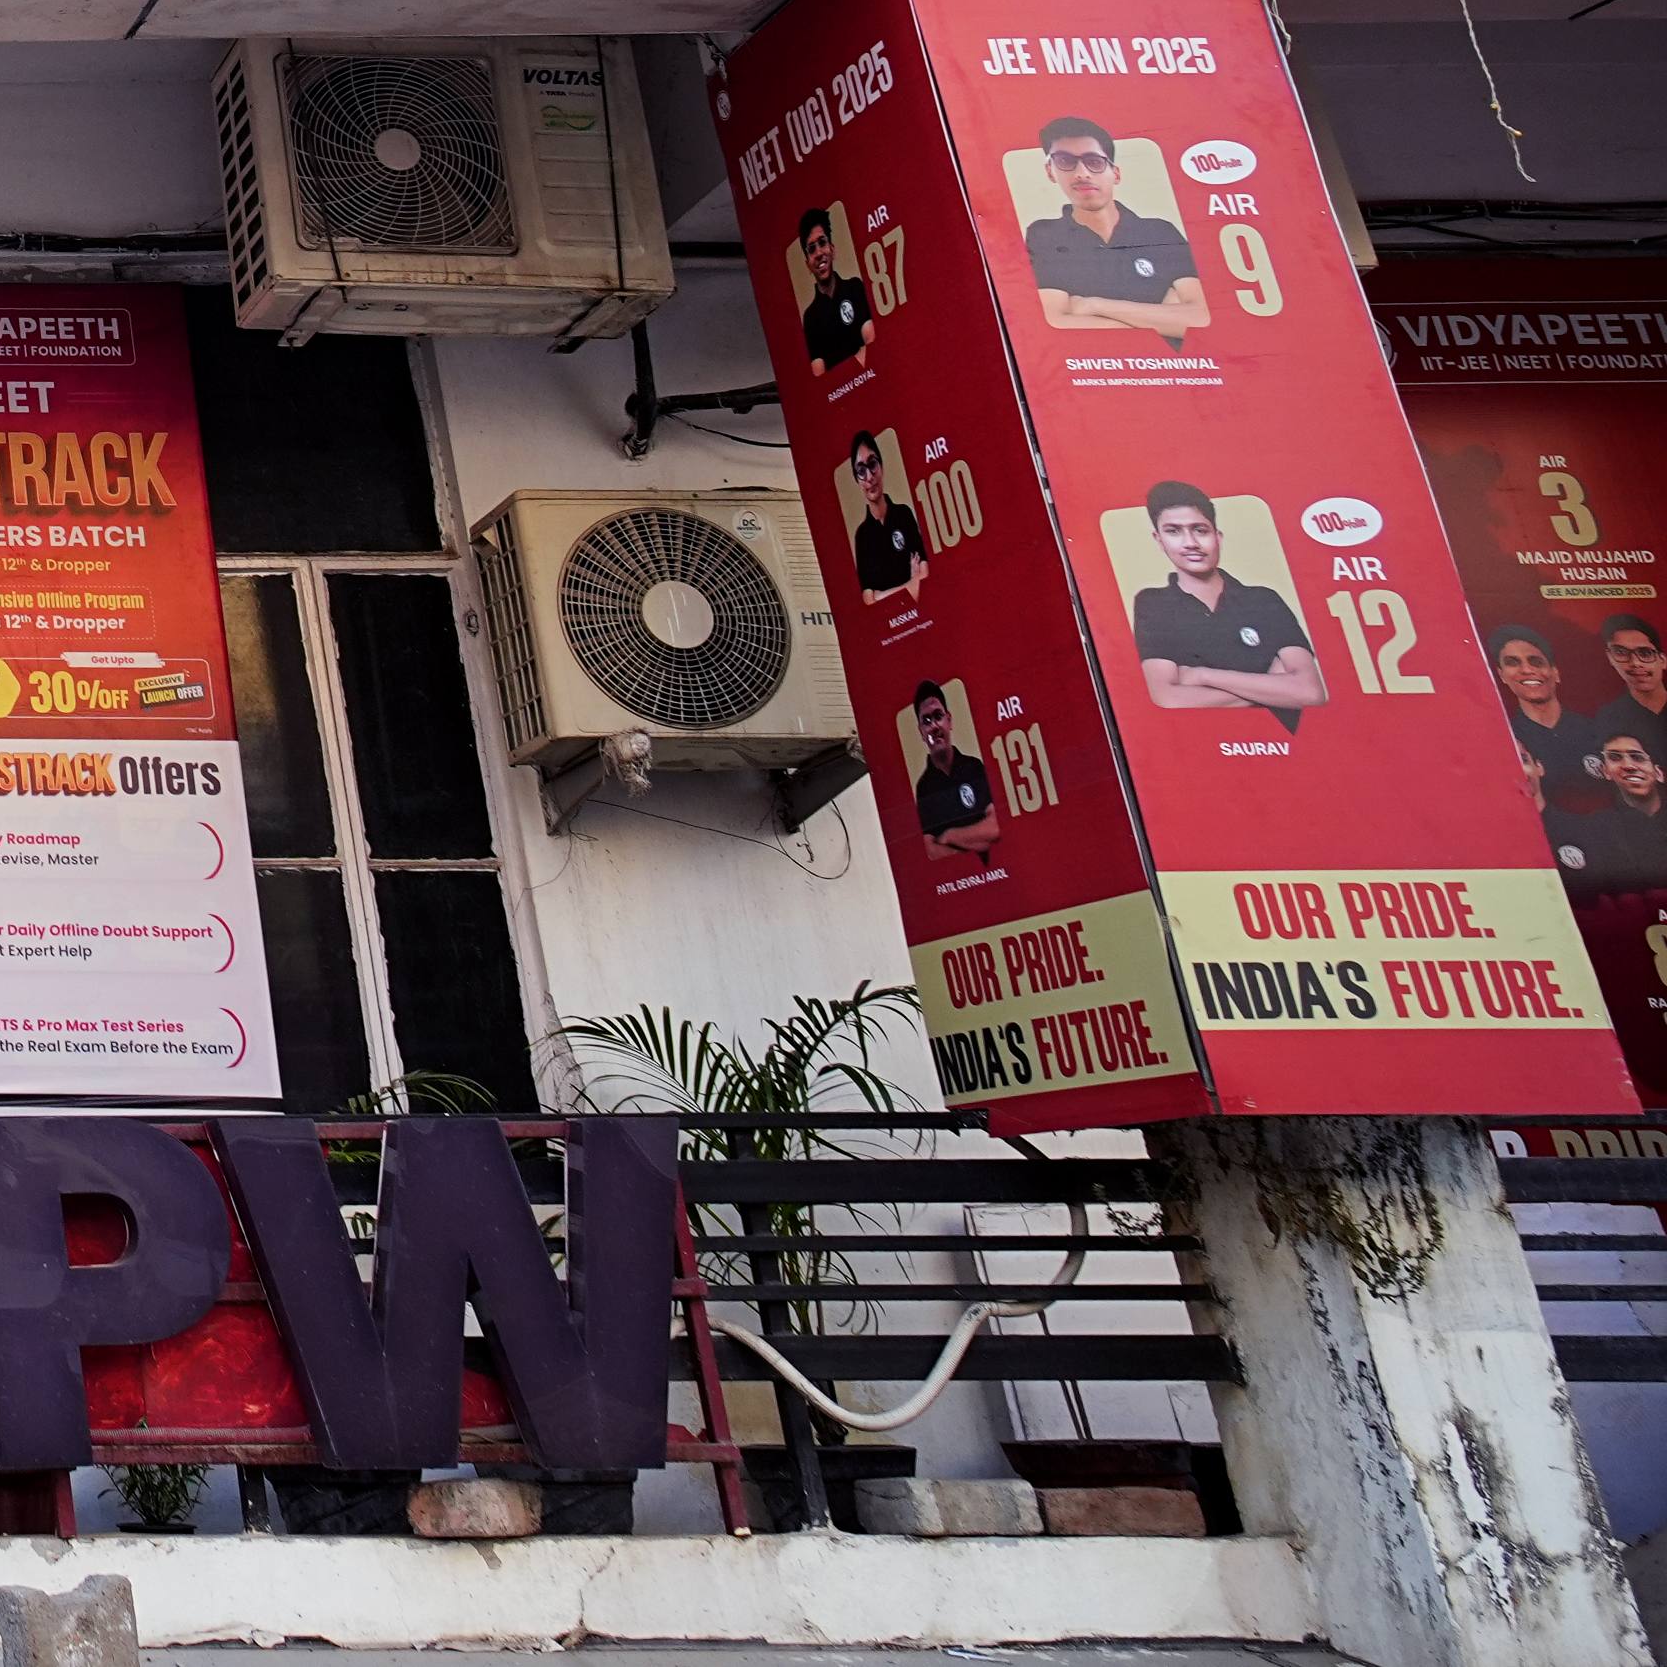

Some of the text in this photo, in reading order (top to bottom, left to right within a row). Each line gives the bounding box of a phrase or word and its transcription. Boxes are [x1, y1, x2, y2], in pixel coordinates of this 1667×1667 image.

[983, 38, 1216, 75] JEE MAIN 2025
[523, 69, 604, 86] VOLTAS
[740, 41, 893, 200] NEET (UG) 2025
[1207, 194, 1259, 215] AIR
[866, 205, 890, 232] AIR
[864, 226, 908, 317] 87
[1219, 224, 1283, 317] 9
[31, 346, 121, 357] FOUNDATION
[1066, 358, 1219, 370] SHIVEN TOSHNIWAL
[925, 437, 948, 463] AIR
[1539, 455, 1567, 469] AIR
[916, 460, 983, 555] 100
[1541, 471, 1599, 546] 3
[49, 526, 146, 547] BATCH
[1333, 557, 1386, 582] AIR
[1516, 551, 1654, 565] MAJID MUJAHID
[1560, 568, 1626, 581] HUSAIN
[38, 593, 80, 609] Offline
[84, 593, 144, 611] Program
[1328, 591, 1434, 695] 12
[137, 674, 183, 688] EXCLUSIVE
[143, 686, 204, 703] LAUNCH OFFER
[996, 696, 1024, 721] AIR
[1219, 742, 1290, 757] SAURAV
[119, 757, 221, 795] Offers
[991, 723, 1059, 817] 131
[7, 833, 81, 847] Roadmap
[1233, 883, 1495, 939] OUR PRIDE.
[7, 924, 45, 939] Daily
[50, 924, 98, 937] Offline
[103, 925, 148, 937] Doubt
[152, 926, 213, 940] Support
[8, 946, 55, 961] Expert
[59, 946, 92, 960] Help
[942, 921, 1104, 1009] OUR PRIDE.
[1382, 961, 1584, 1020] FUTURE.
[37, 1020, 62, 1032] Pro
[66, 1020, 98, 1033] Max
[101, 1020, 133, 1033] Test
[137, 1020, 183, 1033] Series
[29, 1041, 61, 1053] Real
[65, 1041, 106, 1054] Exam
[111, 1041, 159, 1054] Before
[1033, 1001, 1168, 1082] FUTURE.
